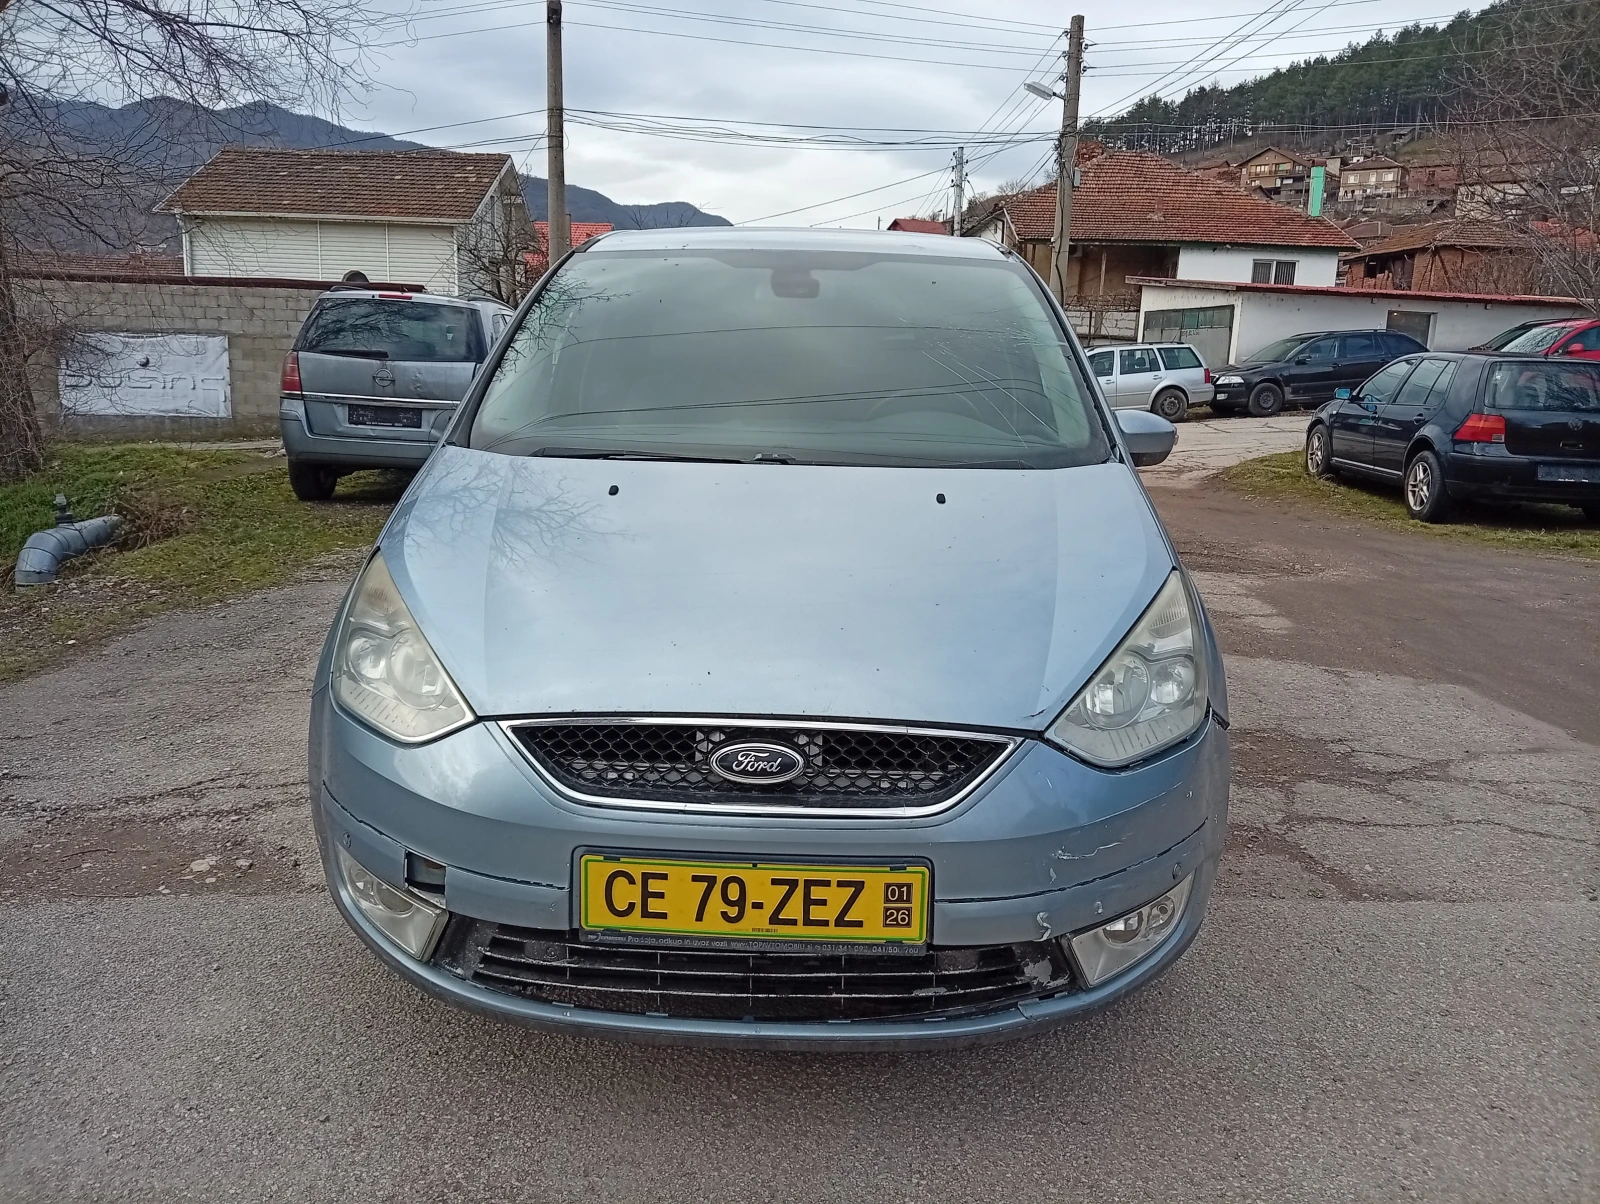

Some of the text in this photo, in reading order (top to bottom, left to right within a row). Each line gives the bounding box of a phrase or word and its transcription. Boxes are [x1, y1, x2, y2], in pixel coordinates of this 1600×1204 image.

[732, 751, 782, 772] Ford
[604, 869, 866, 928] CE 79-ZEZ
[888, 885, 909, 901] 01
[886, 909, 909, 926] 26
